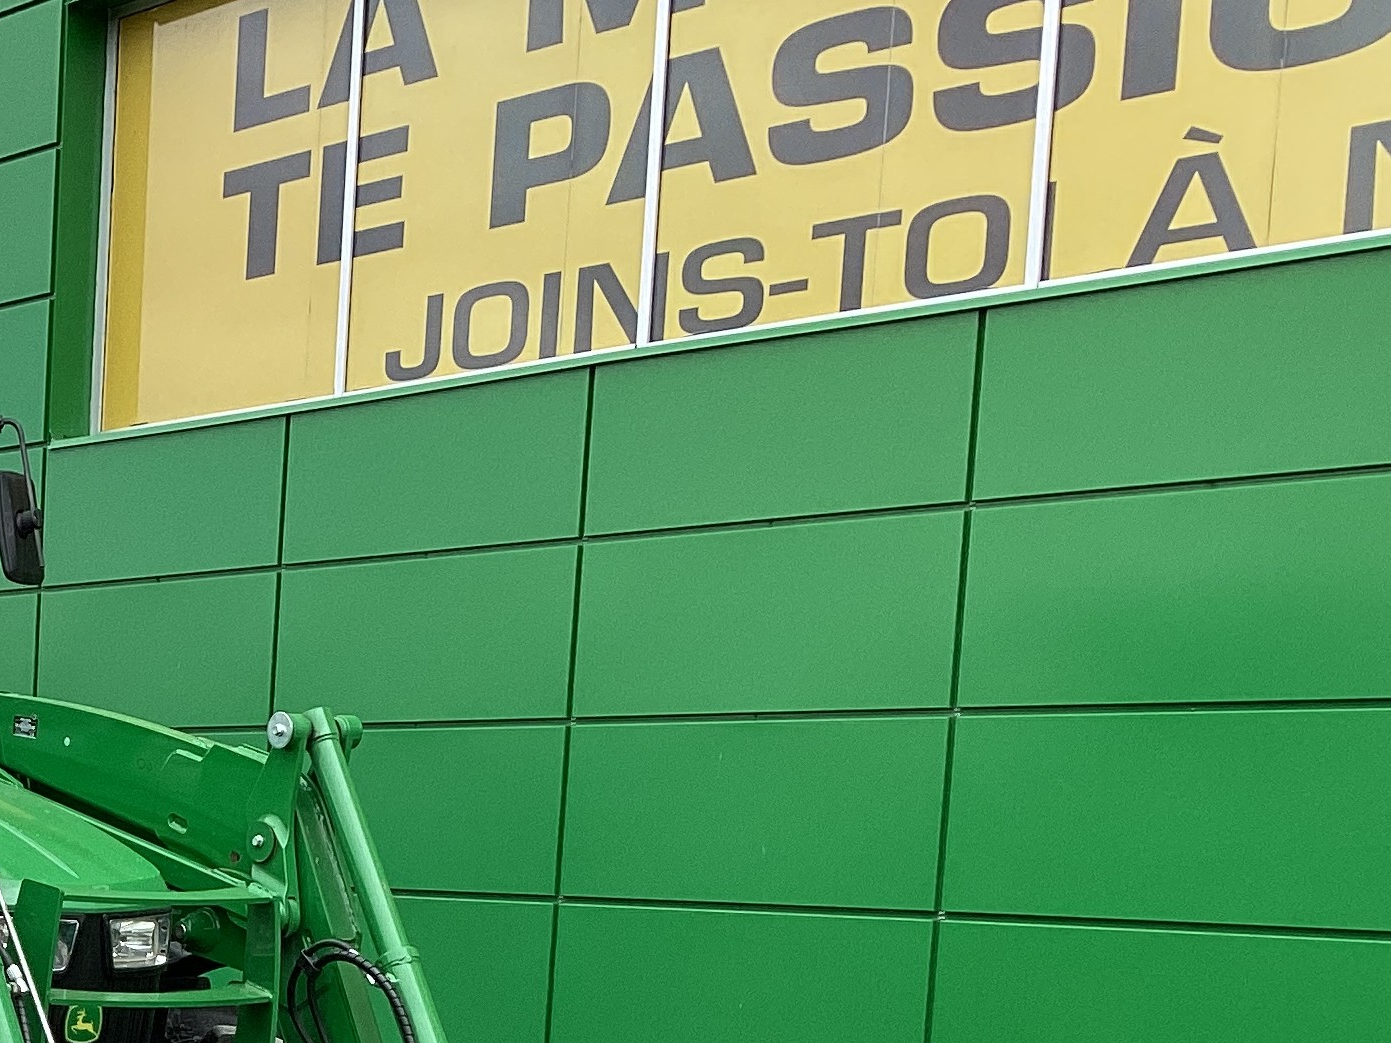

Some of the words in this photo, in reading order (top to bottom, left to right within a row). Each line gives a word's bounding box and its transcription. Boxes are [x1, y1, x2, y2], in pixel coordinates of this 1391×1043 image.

[233, 0, 438, 133] LA
[223, 125, 409, 280] TE
[1125, 126, 1257, 268] À
